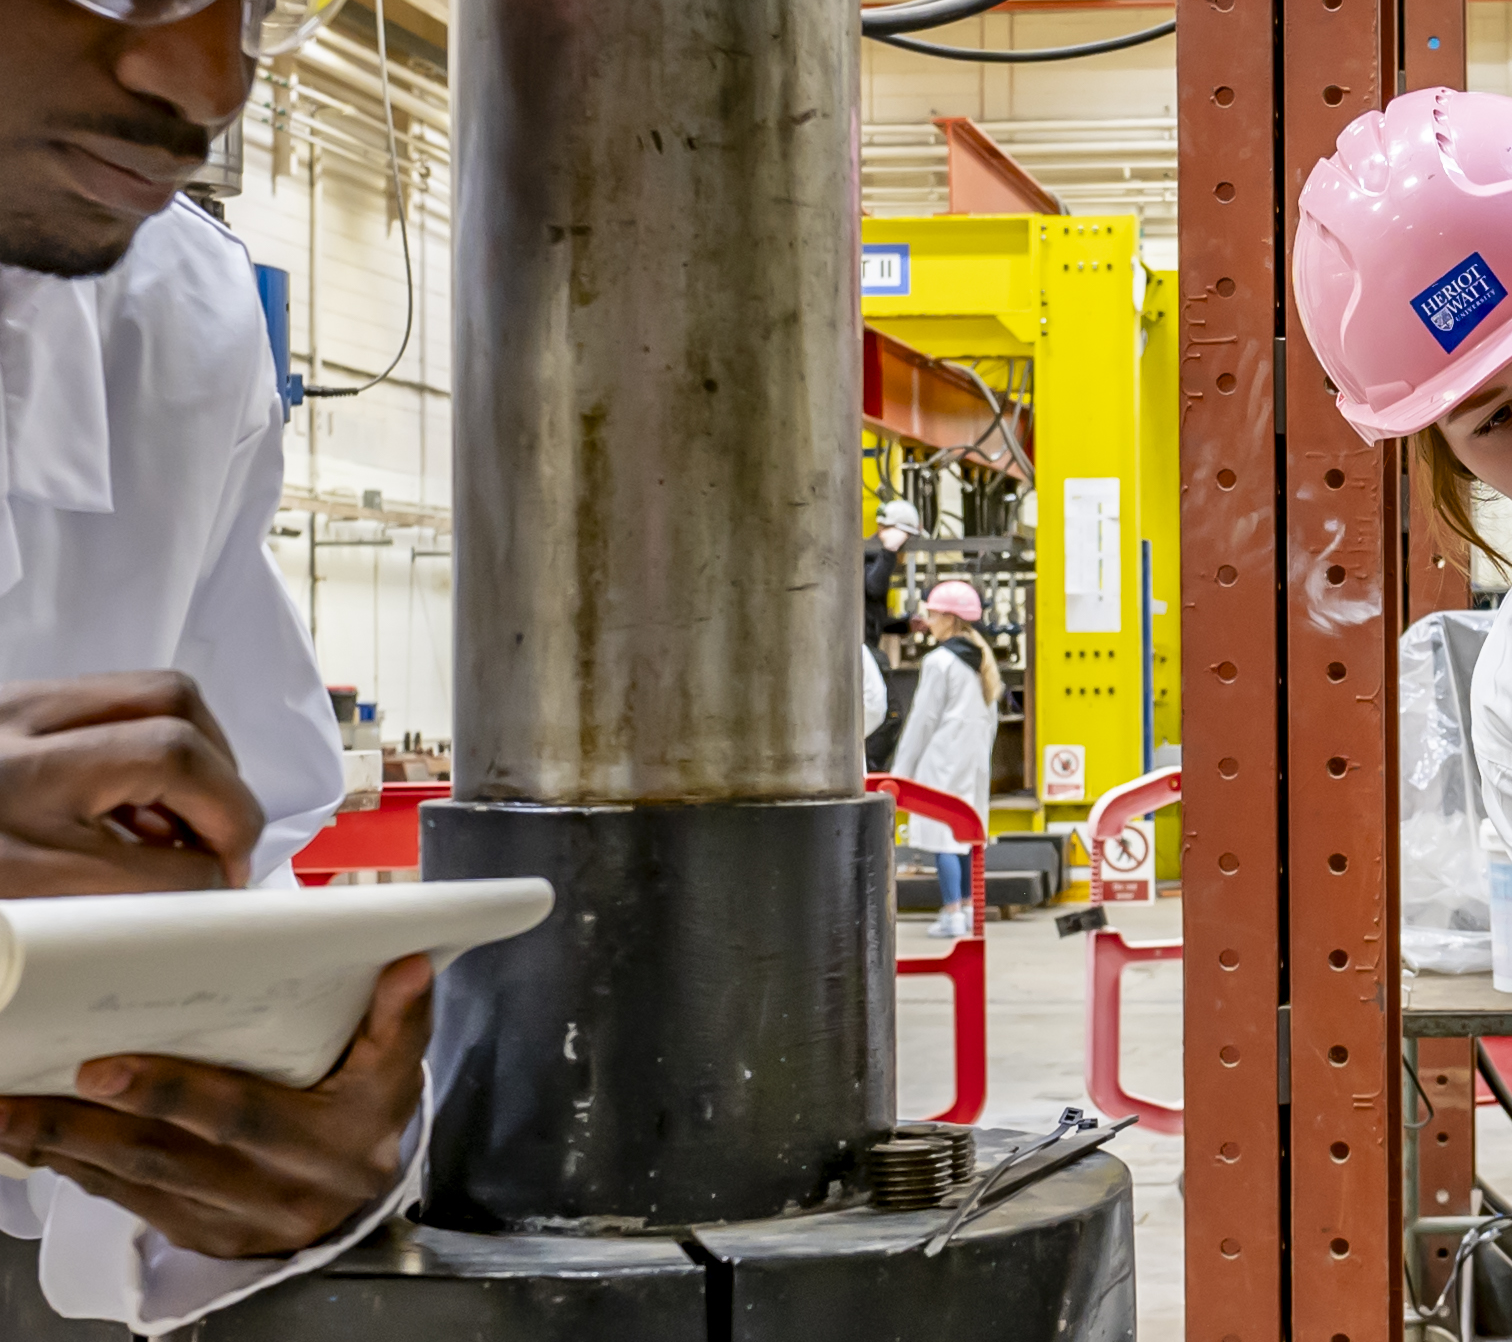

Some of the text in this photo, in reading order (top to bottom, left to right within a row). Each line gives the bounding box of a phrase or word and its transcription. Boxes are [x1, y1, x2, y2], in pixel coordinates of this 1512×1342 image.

[1420, 263, 1482, 317] HERIOT
[1445, 275, 1490, 315] WATT
[1455, 288, 1497, 322] UNIVERSITY
